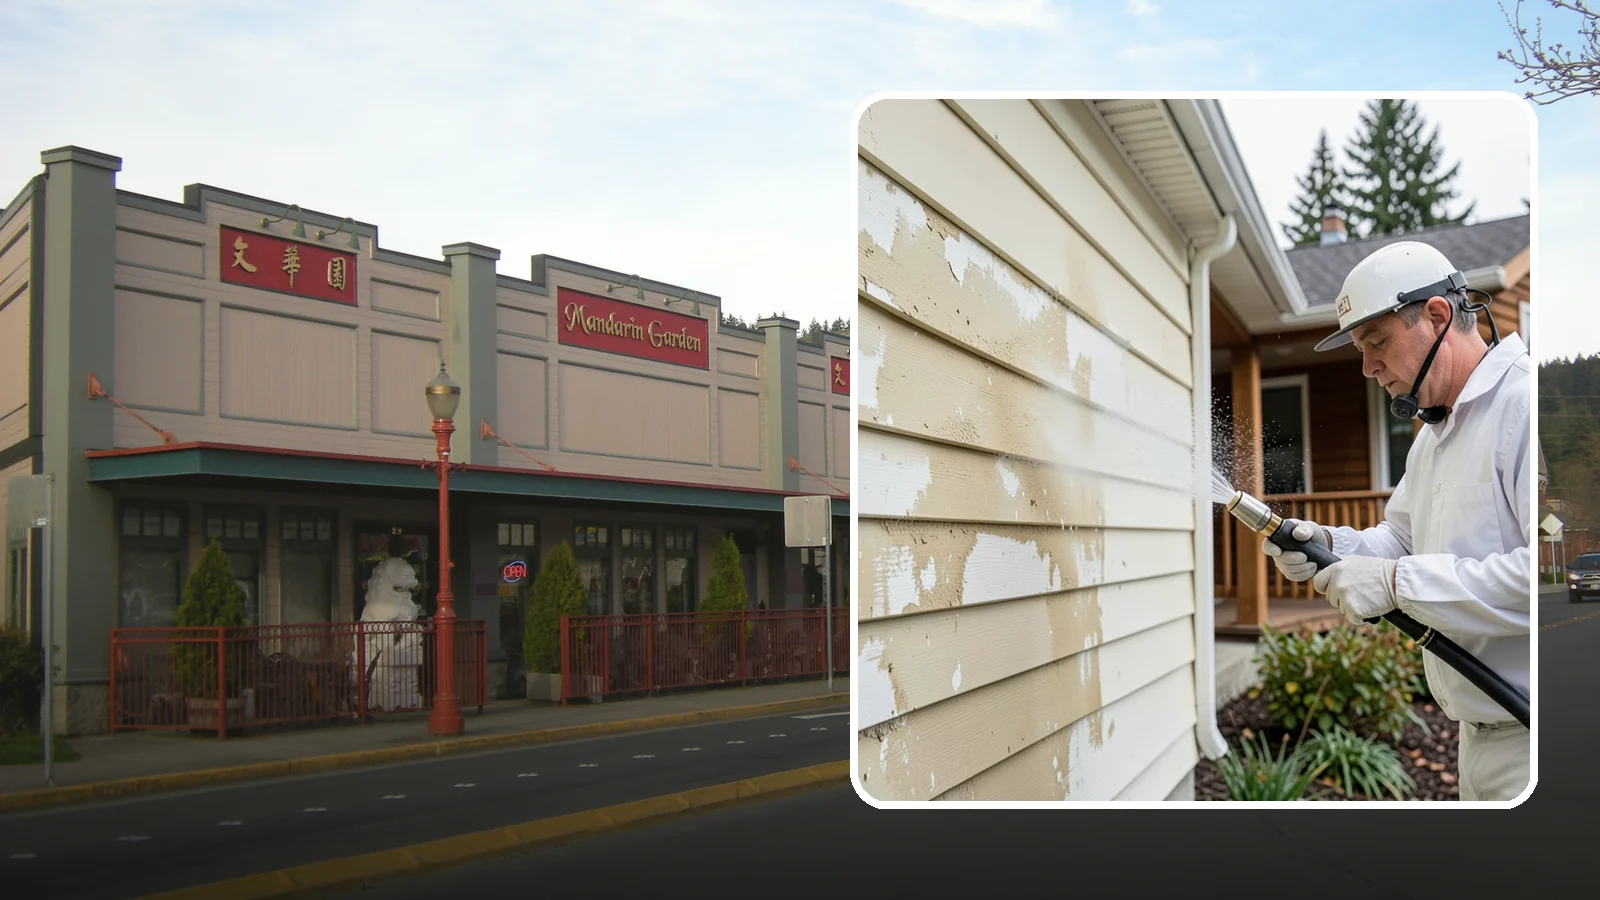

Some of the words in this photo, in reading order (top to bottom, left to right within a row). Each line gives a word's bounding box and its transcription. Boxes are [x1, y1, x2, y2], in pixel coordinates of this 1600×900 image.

[564, 302, 644, 341] Mandarin
[648, 320, 701, 352] Garden
[503, 565, 527, 578] OPEN
